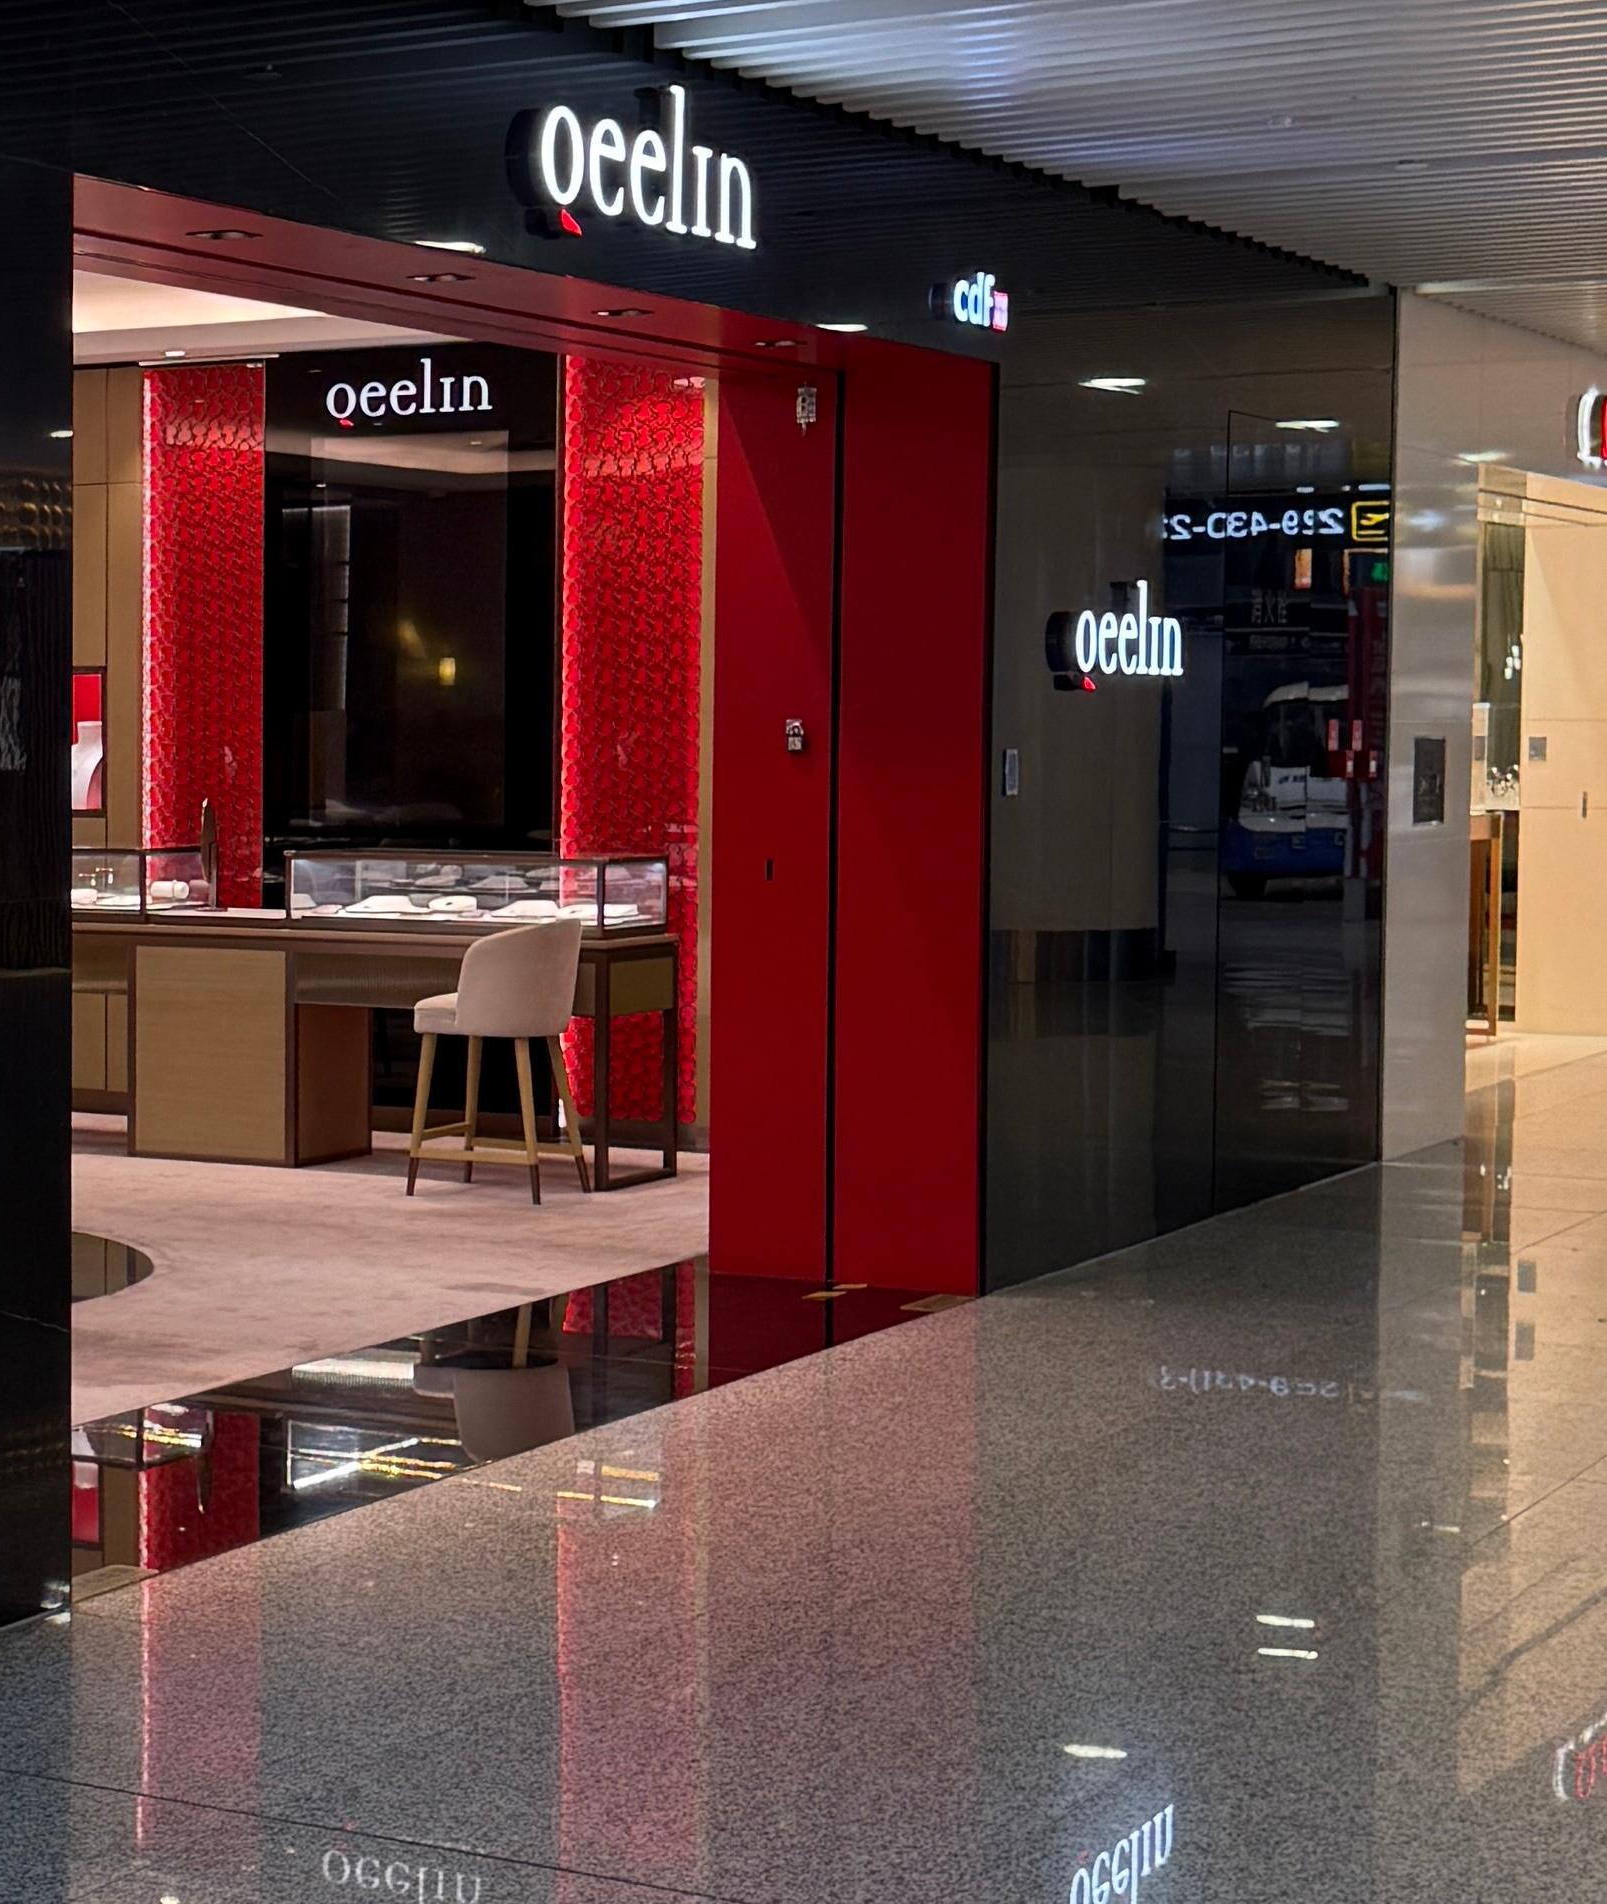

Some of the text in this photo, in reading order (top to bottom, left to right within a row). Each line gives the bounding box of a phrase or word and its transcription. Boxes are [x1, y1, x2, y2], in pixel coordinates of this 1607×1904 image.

[539, 84, 757, 250] Qeelin
[953, 271, 996, 328] cdf
[326, 358, 493, 426] Qeelin
[1075, 579, 1184, 691] Qeelin
